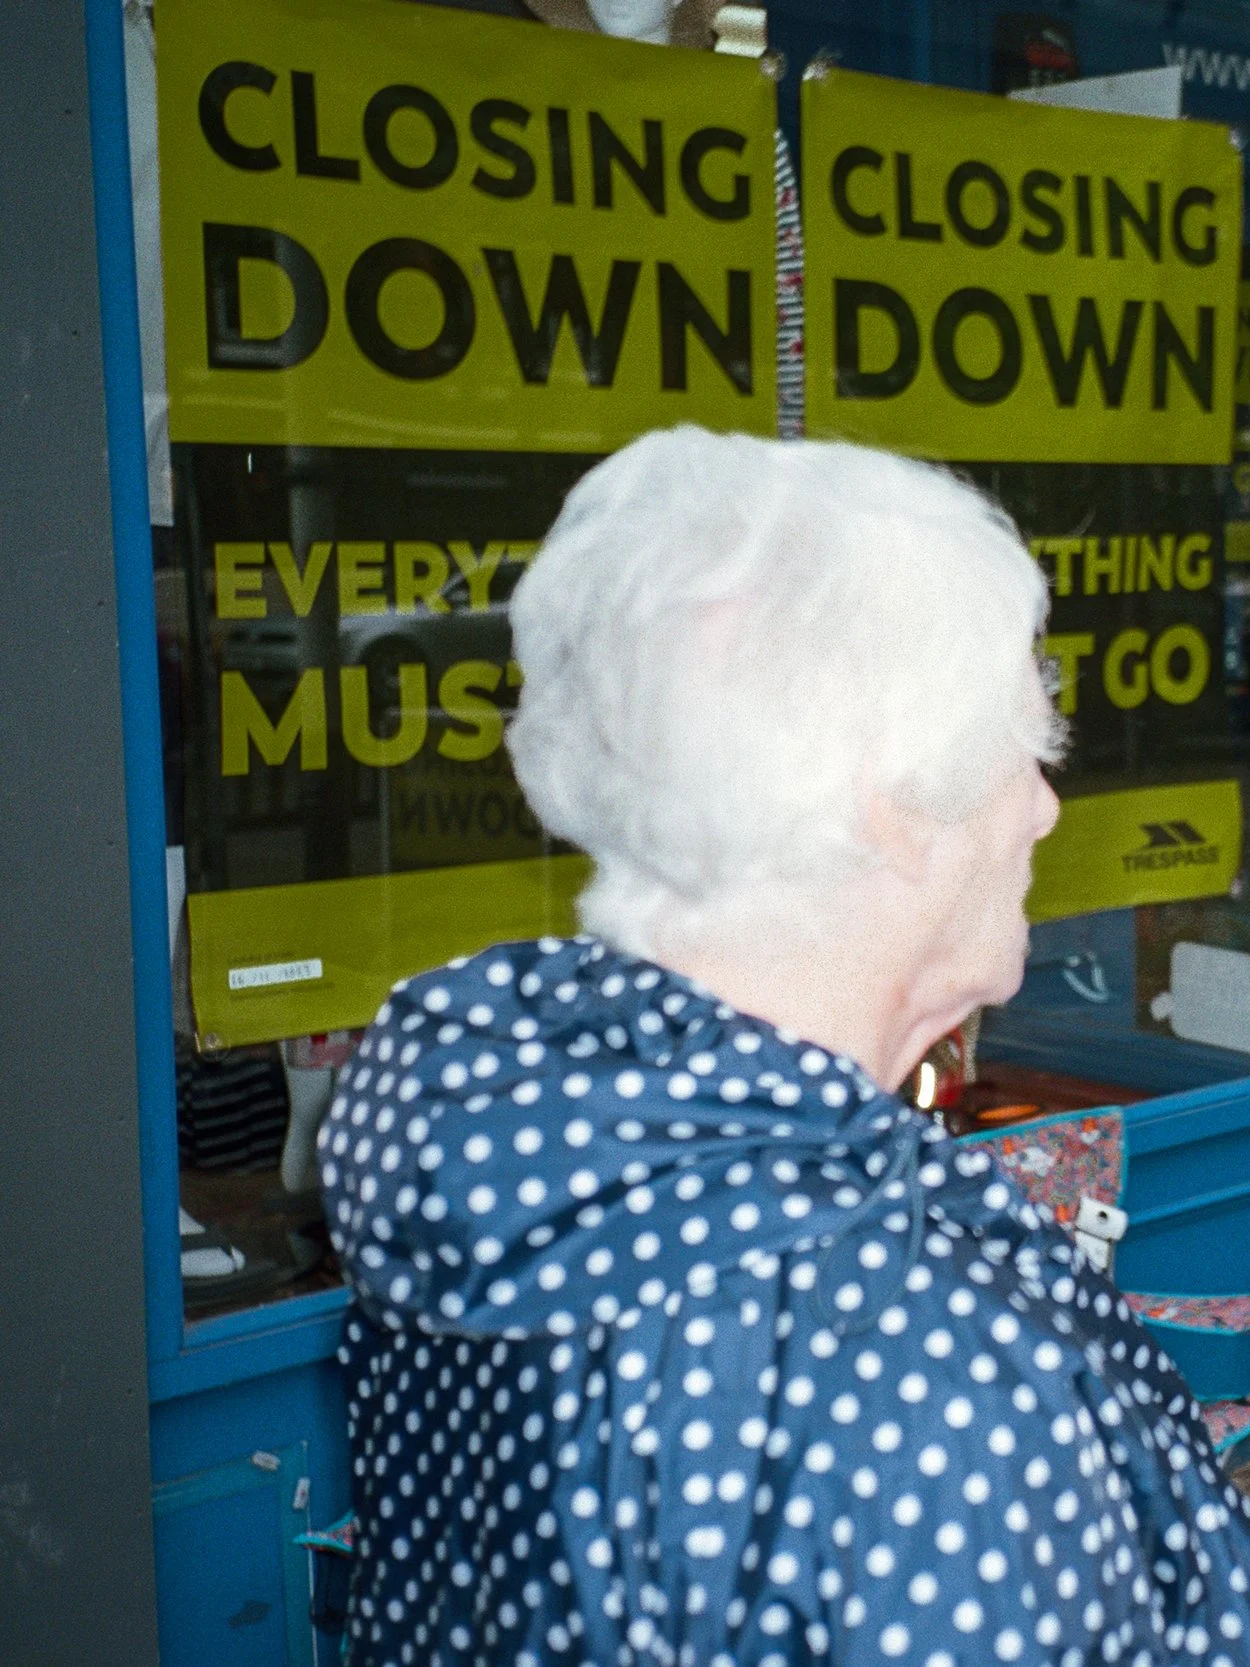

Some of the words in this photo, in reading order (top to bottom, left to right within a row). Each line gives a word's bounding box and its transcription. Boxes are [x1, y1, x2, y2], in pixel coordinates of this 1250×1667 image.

[198, 60, 752, 222] CLOSING
[831, 146, 1218, 266] CLOSING
[201, 220, 754, 398] DOWN
[835, 279, 1216, 412] DOWN
[214, 540, 543, 618] EVERY
[1029, 533, 1213, 596] THING
[221, 660, 524, 775] MUS
[1103, 624, 1210, 709] GO
[1121, 846, 1220, 873] TRESPASS
